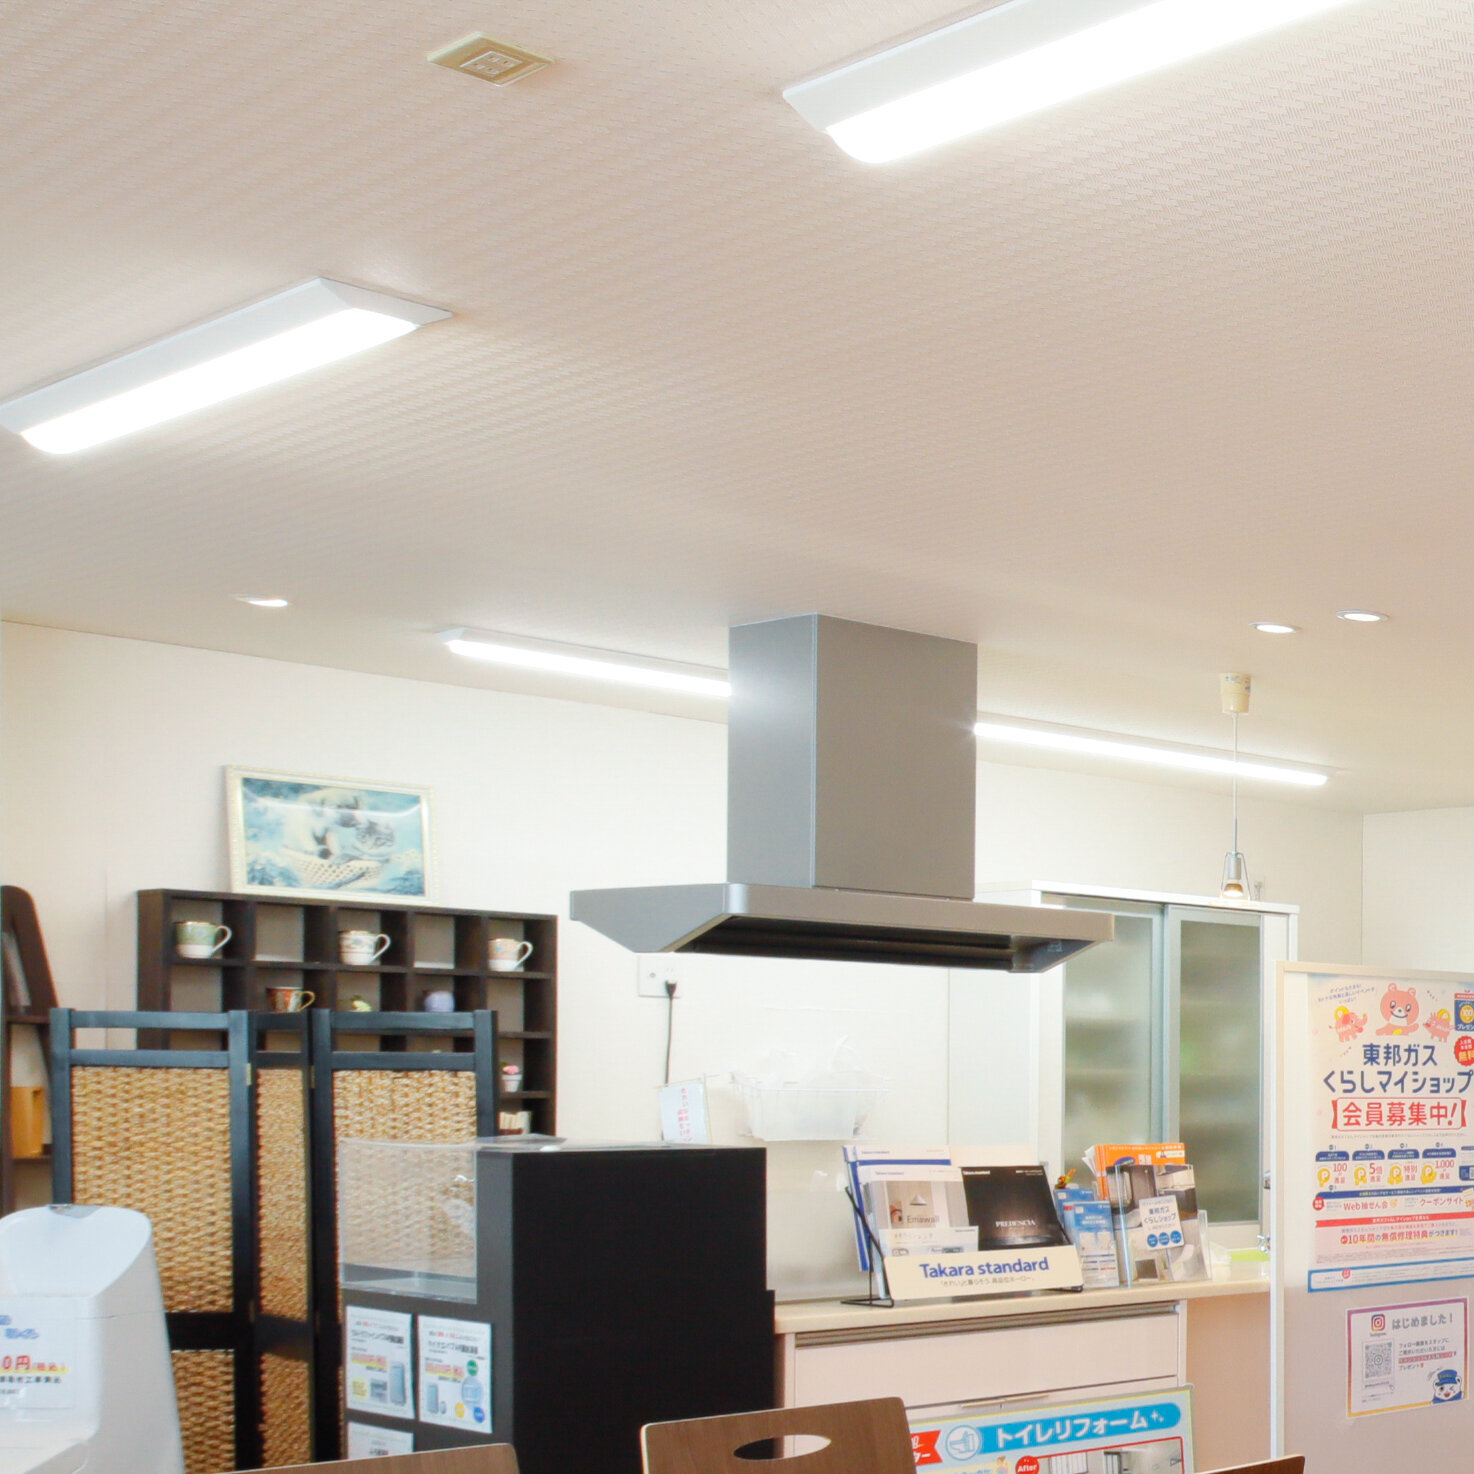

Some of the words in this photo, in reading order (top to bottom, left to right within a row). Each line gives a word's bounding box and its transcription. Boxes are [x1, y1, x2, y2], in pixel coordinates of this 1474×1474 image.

[1362, 1042, 1438, 1067] 東邦ガス
[1323, 1069, 1474, 1094] くらしマイショップ
[906, 1215, 940, 1225] Emawall
[919, 1262, 974, 1279] Takara
[977, 1256, 1050, 1275] standard
[996, 1409, 1149, 1449] トイレリフォーム
[1017, 1464, 1038, 1474] After
